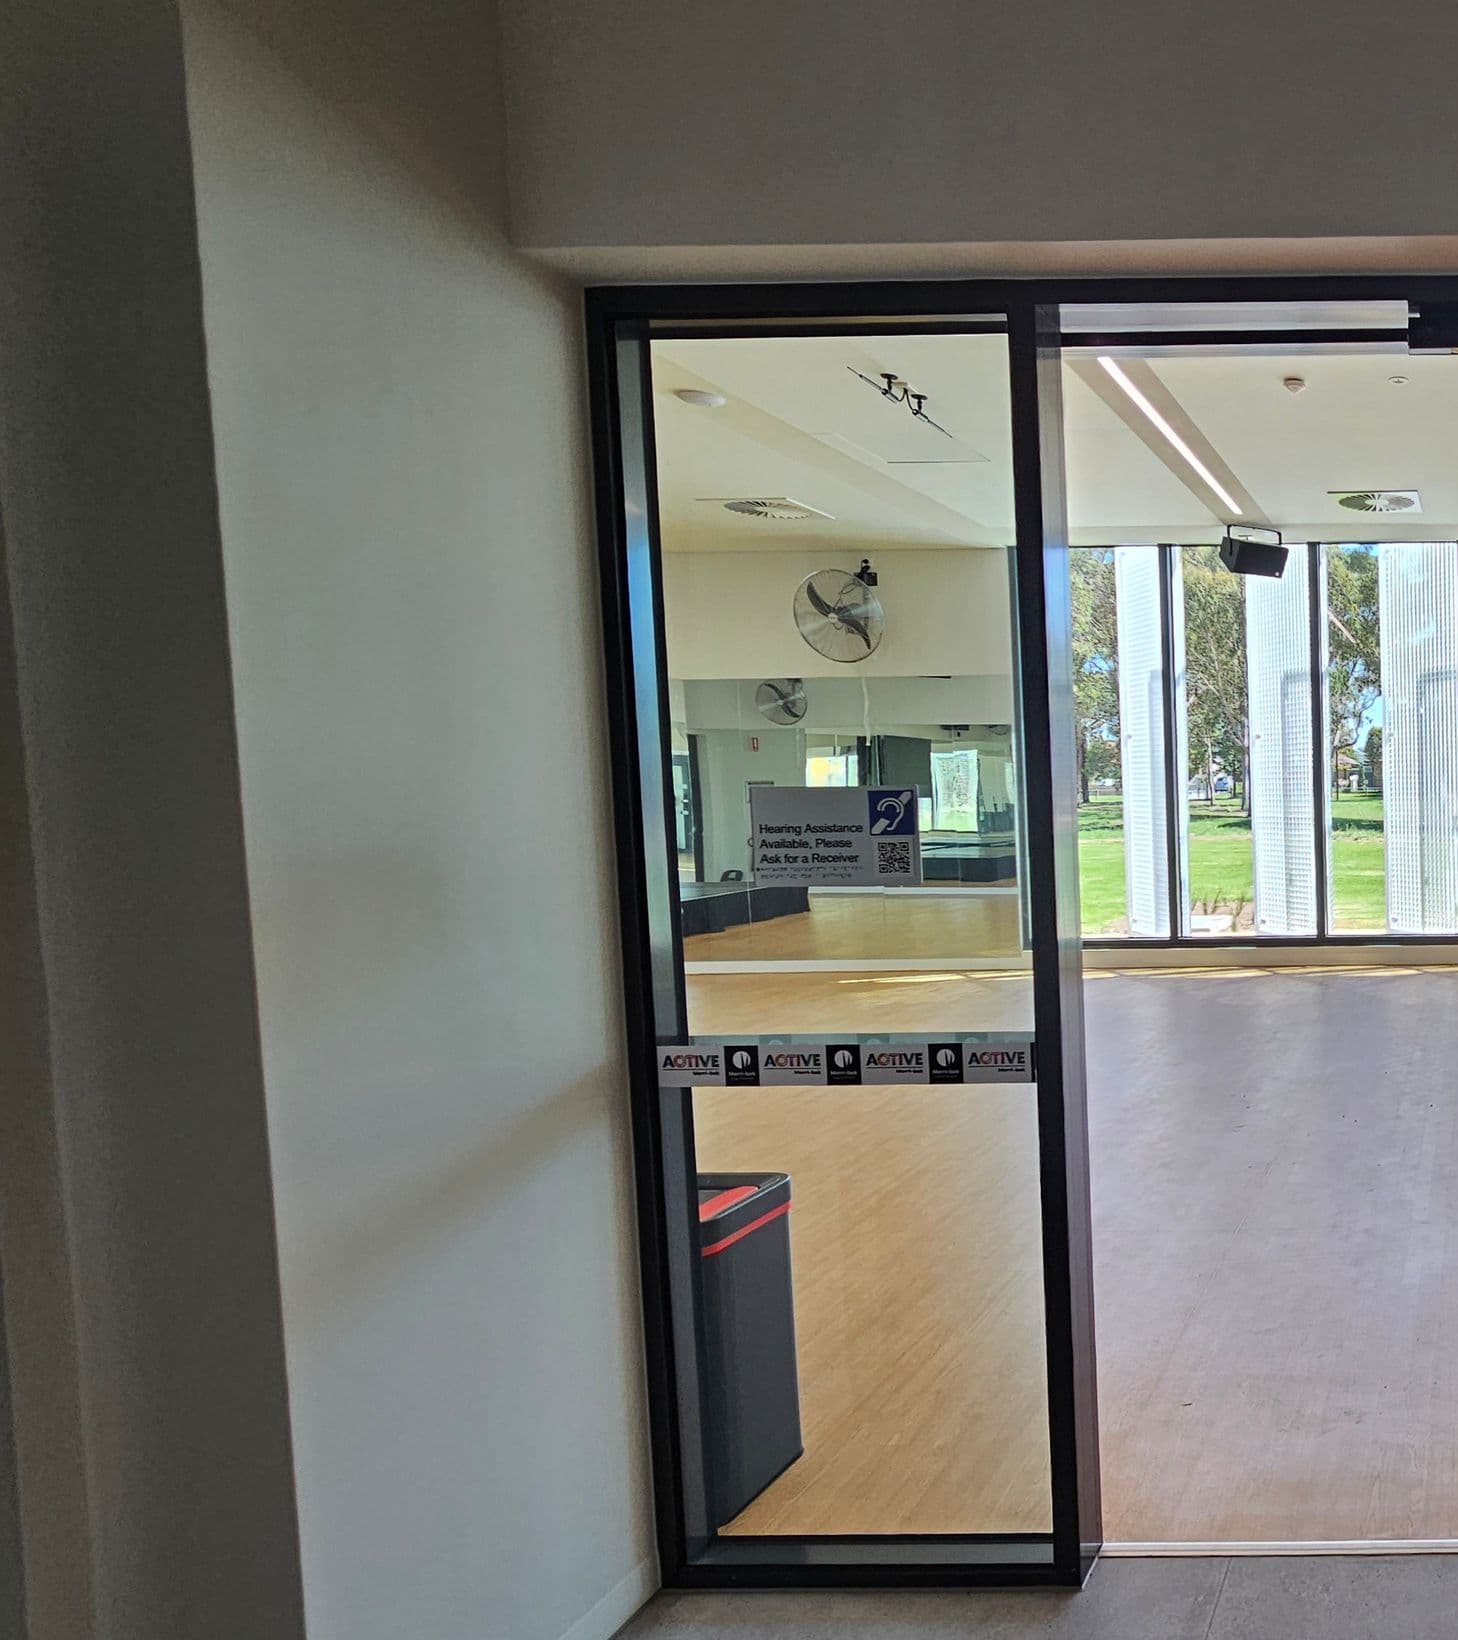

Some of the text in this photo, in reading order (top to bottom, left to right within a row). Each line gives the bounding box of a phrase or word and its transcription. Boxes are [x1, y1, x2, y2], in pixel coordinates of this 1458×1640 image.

[759, 824, 863, 836] Hearing Assistance
[760, 838, 852, 849] Available, Please
[760, 855, 781, 863] Ask
[784, 854, 798, 863] for
[812, 853, 859, 863] Receiver
[662, 1054, 719, 1068] ACTIVE
[764, 1053, 821, 1067] ACTIVE
[866, 1052, 923, 1066] ACTIVE
[968, 1051, 1026, 1065] ACTIVE
